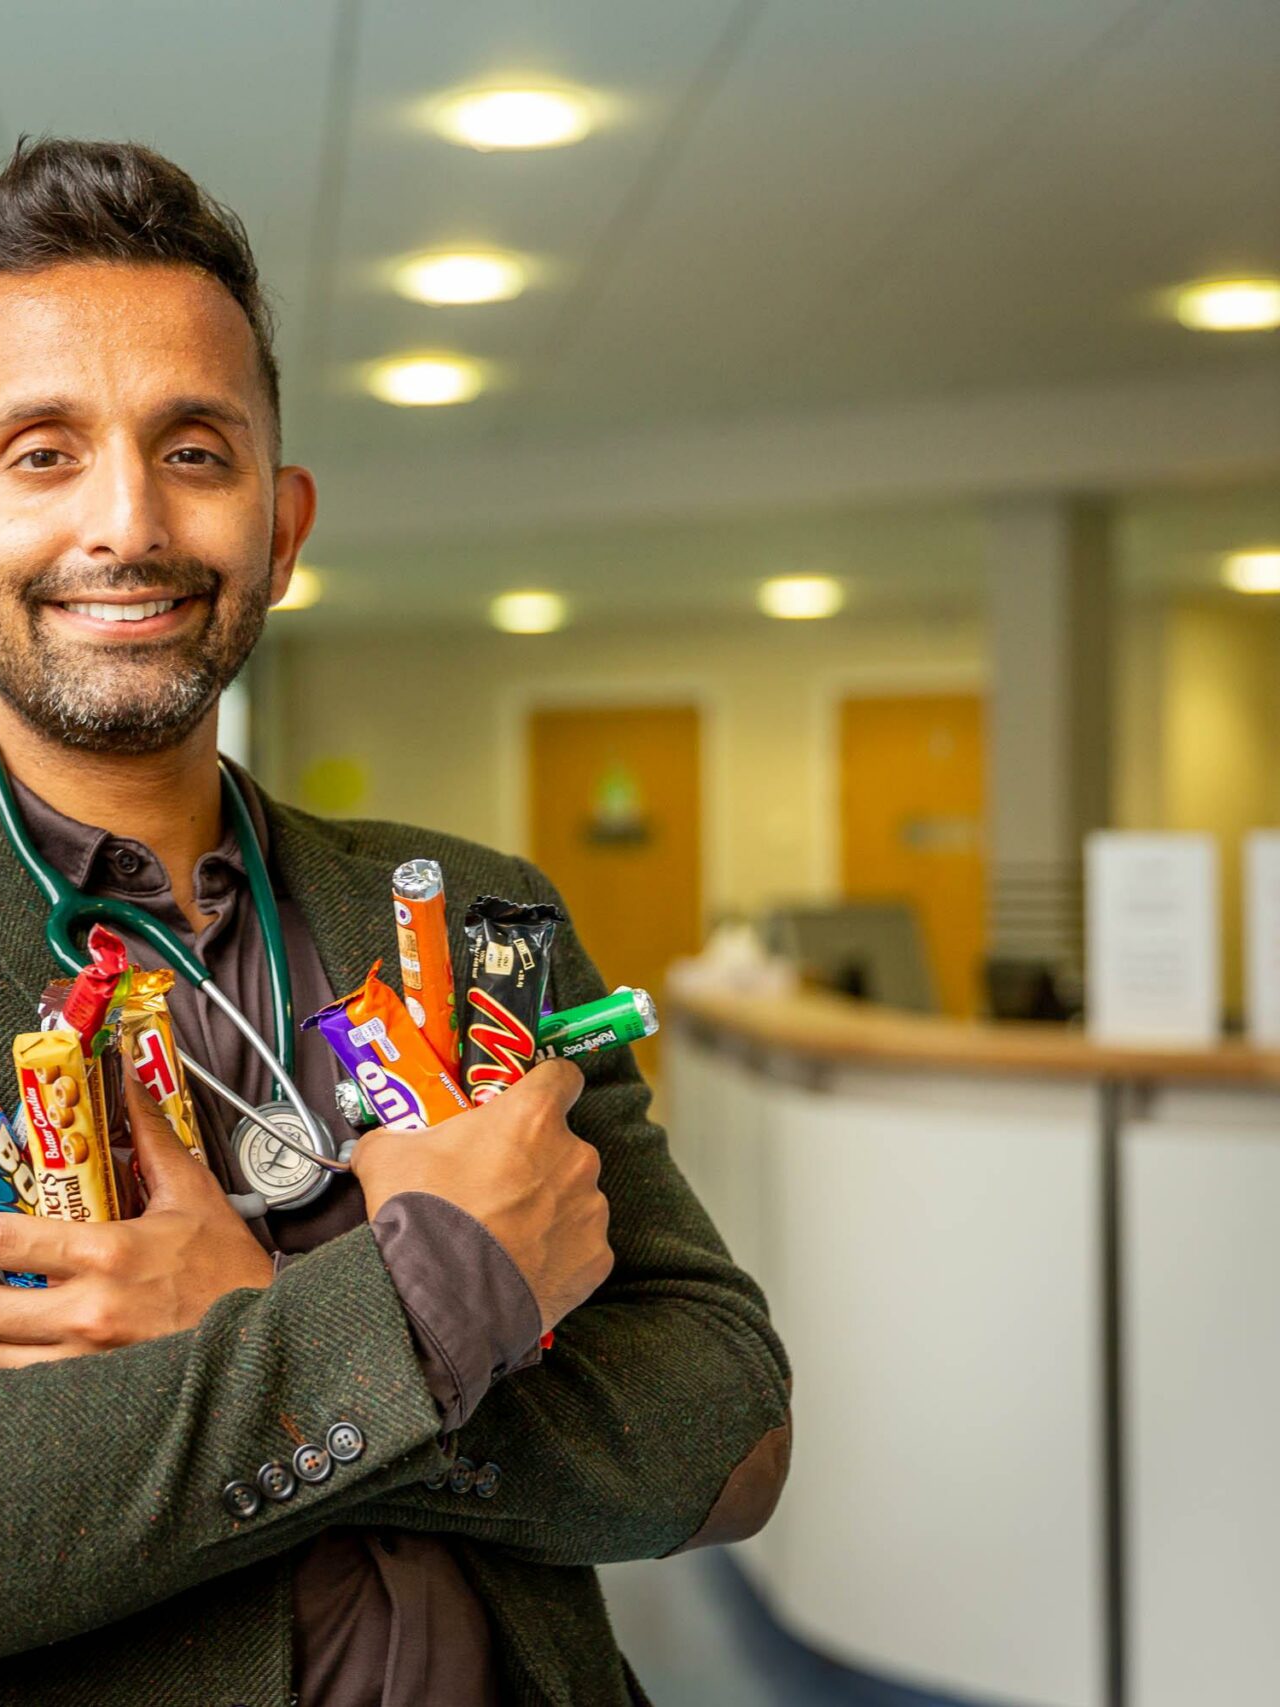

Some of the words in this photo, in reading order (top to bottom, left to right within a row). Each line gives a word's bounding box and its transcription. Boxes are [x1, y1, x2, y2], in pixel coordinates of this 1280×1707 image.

[134, 1029, 179, 1105] T
[27, 1087, 48, 1127] Candies
[439, 1072, 468, 1108] chocolate
[44, 1129, 60, 1160] Butter
